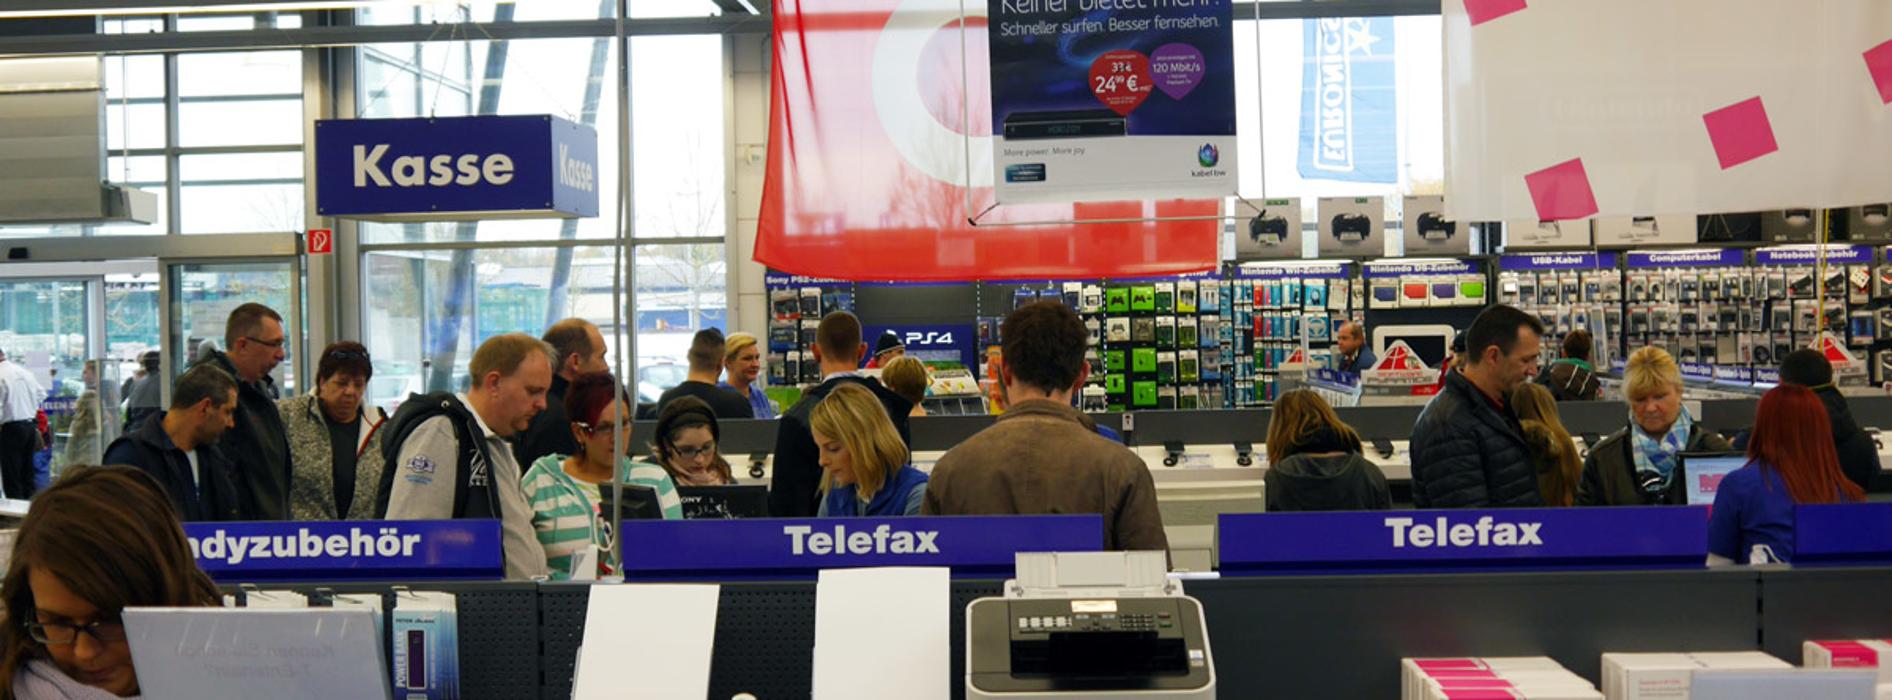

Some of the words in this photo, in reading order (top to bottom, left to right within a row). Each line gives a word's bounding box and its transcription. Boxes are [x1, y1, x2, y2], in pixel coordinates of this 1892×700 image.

[1001, 20, 1058, 36] Schneller
[1109, 17, 1150, 32] Besser
[1153, 63, 1169, 73] 120
[353, 144, 515, 187] Kasse
[558, 142, 593, 192] Kasse
[1532, 256, 1583, 264] USB-Kabel
[1649, 253, 1721, 263] Computerkabel
[1241, 266, 1283, 275] Nintendo
[1370, 264, 1412, 273] Nintendo
[766, 276, 789, 284] Sony
[906, 332, 953, 345] PS4
[1384, 516, 1543, 547] Telefax
[783, 524, 940, 555] Telefax
